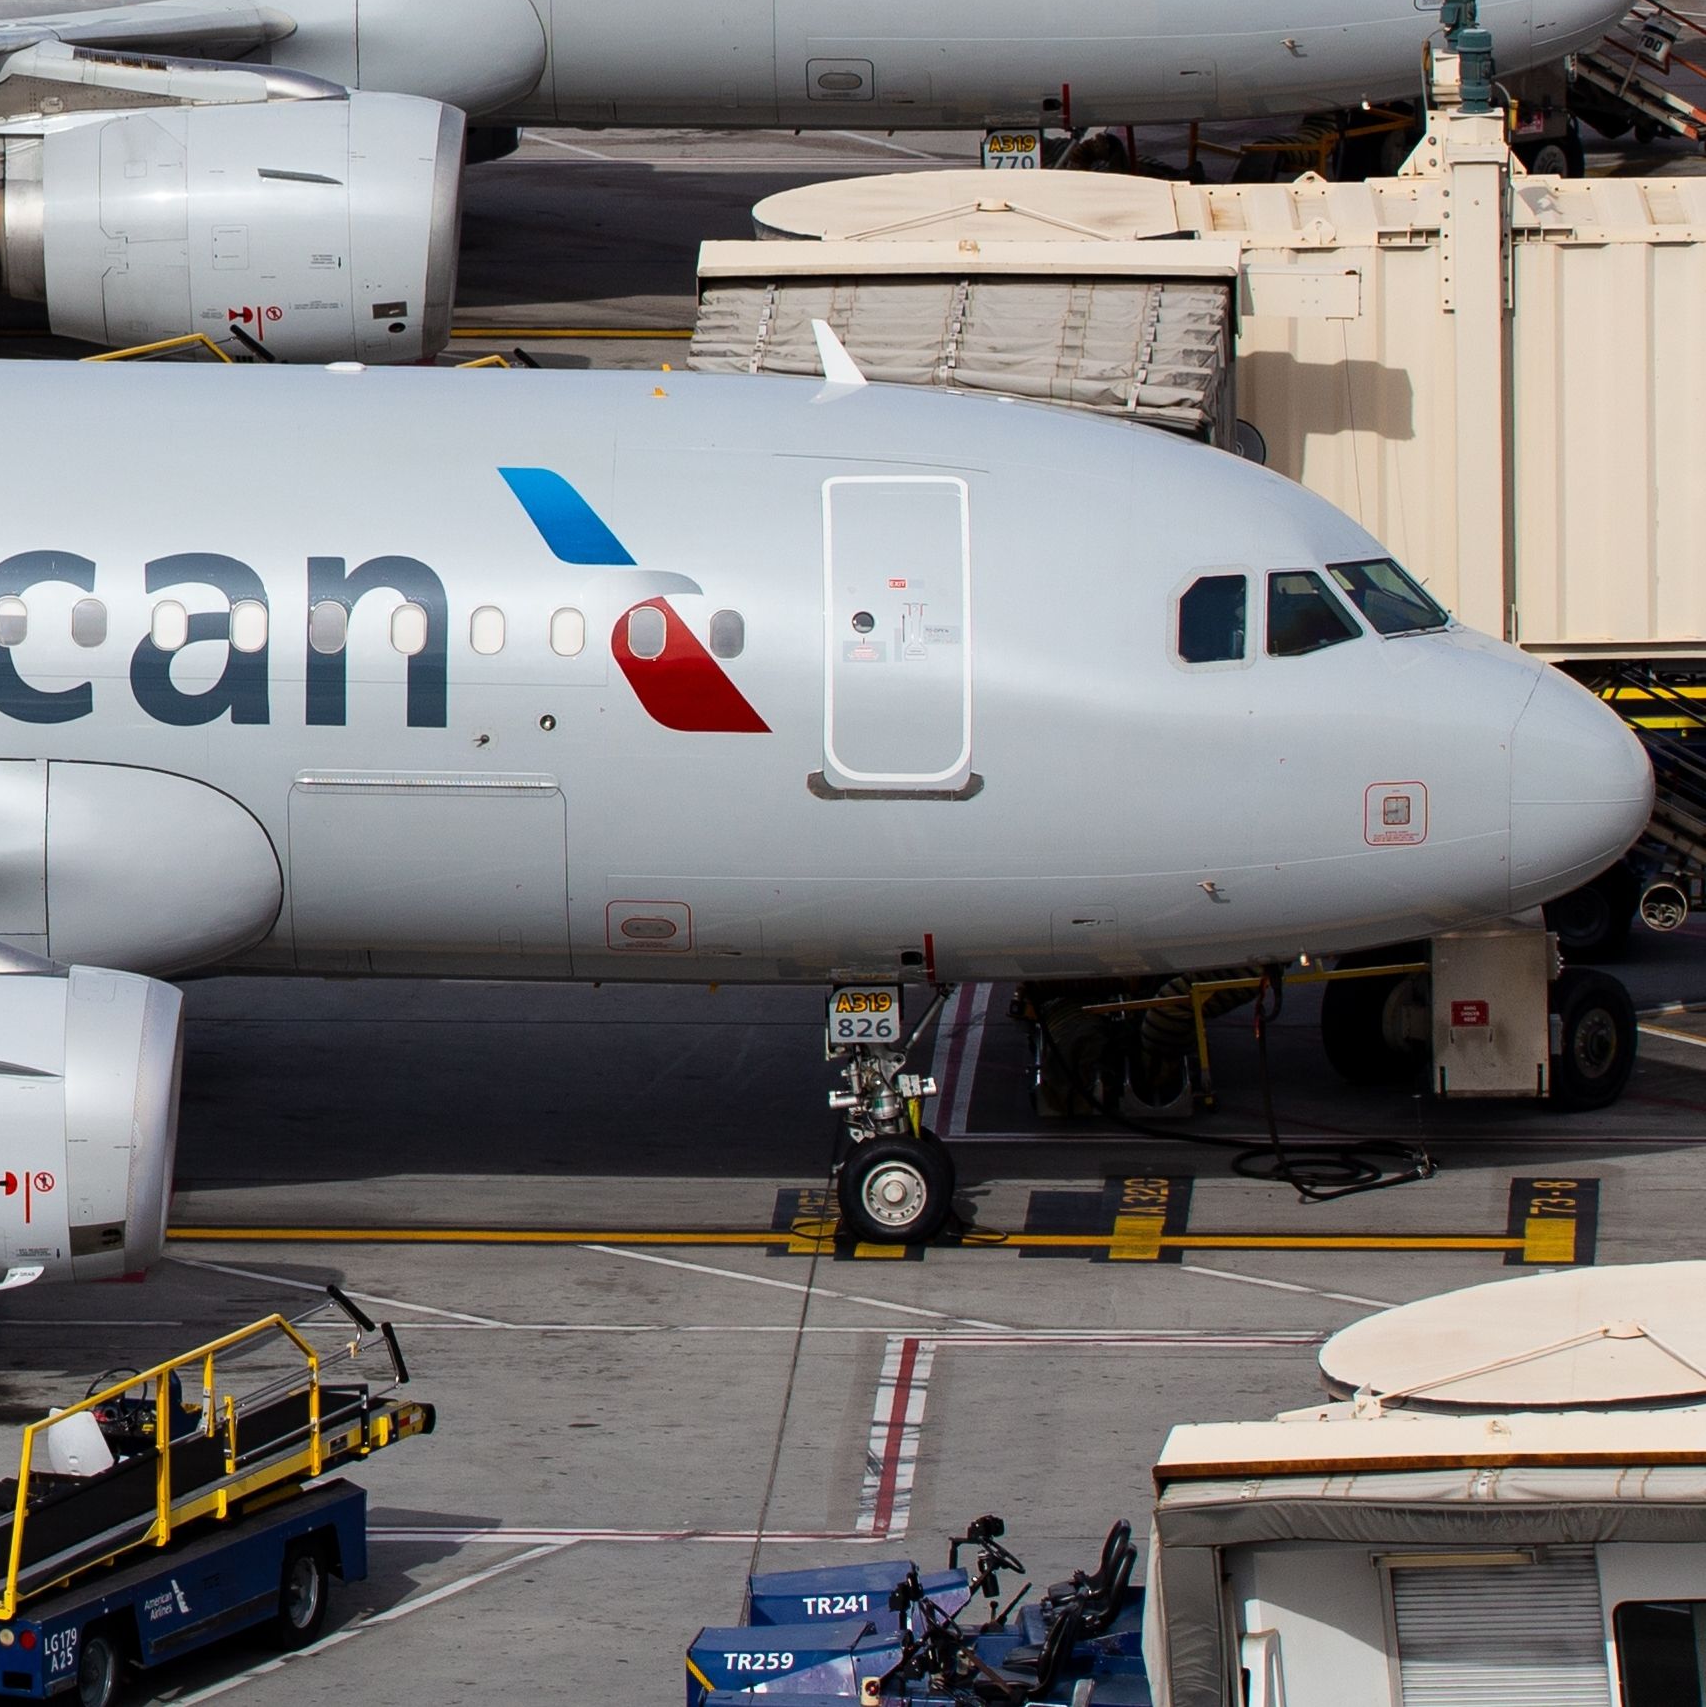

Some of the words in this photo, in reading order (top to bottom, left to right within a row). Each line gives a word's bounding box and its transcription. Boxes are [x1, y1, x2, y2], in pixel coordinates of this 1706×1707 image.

[988, 134, 1037, 154] A319
[835, 992, 892, 1013] A319
[838, 1018, 893, 1038] 826
[144, 1591, 173, 1612] American
[802, 1594, 869, 1615] TR241
[150, 1603, 173, 1622] Airlines
[723, 1652, 794, 1671] TR259
